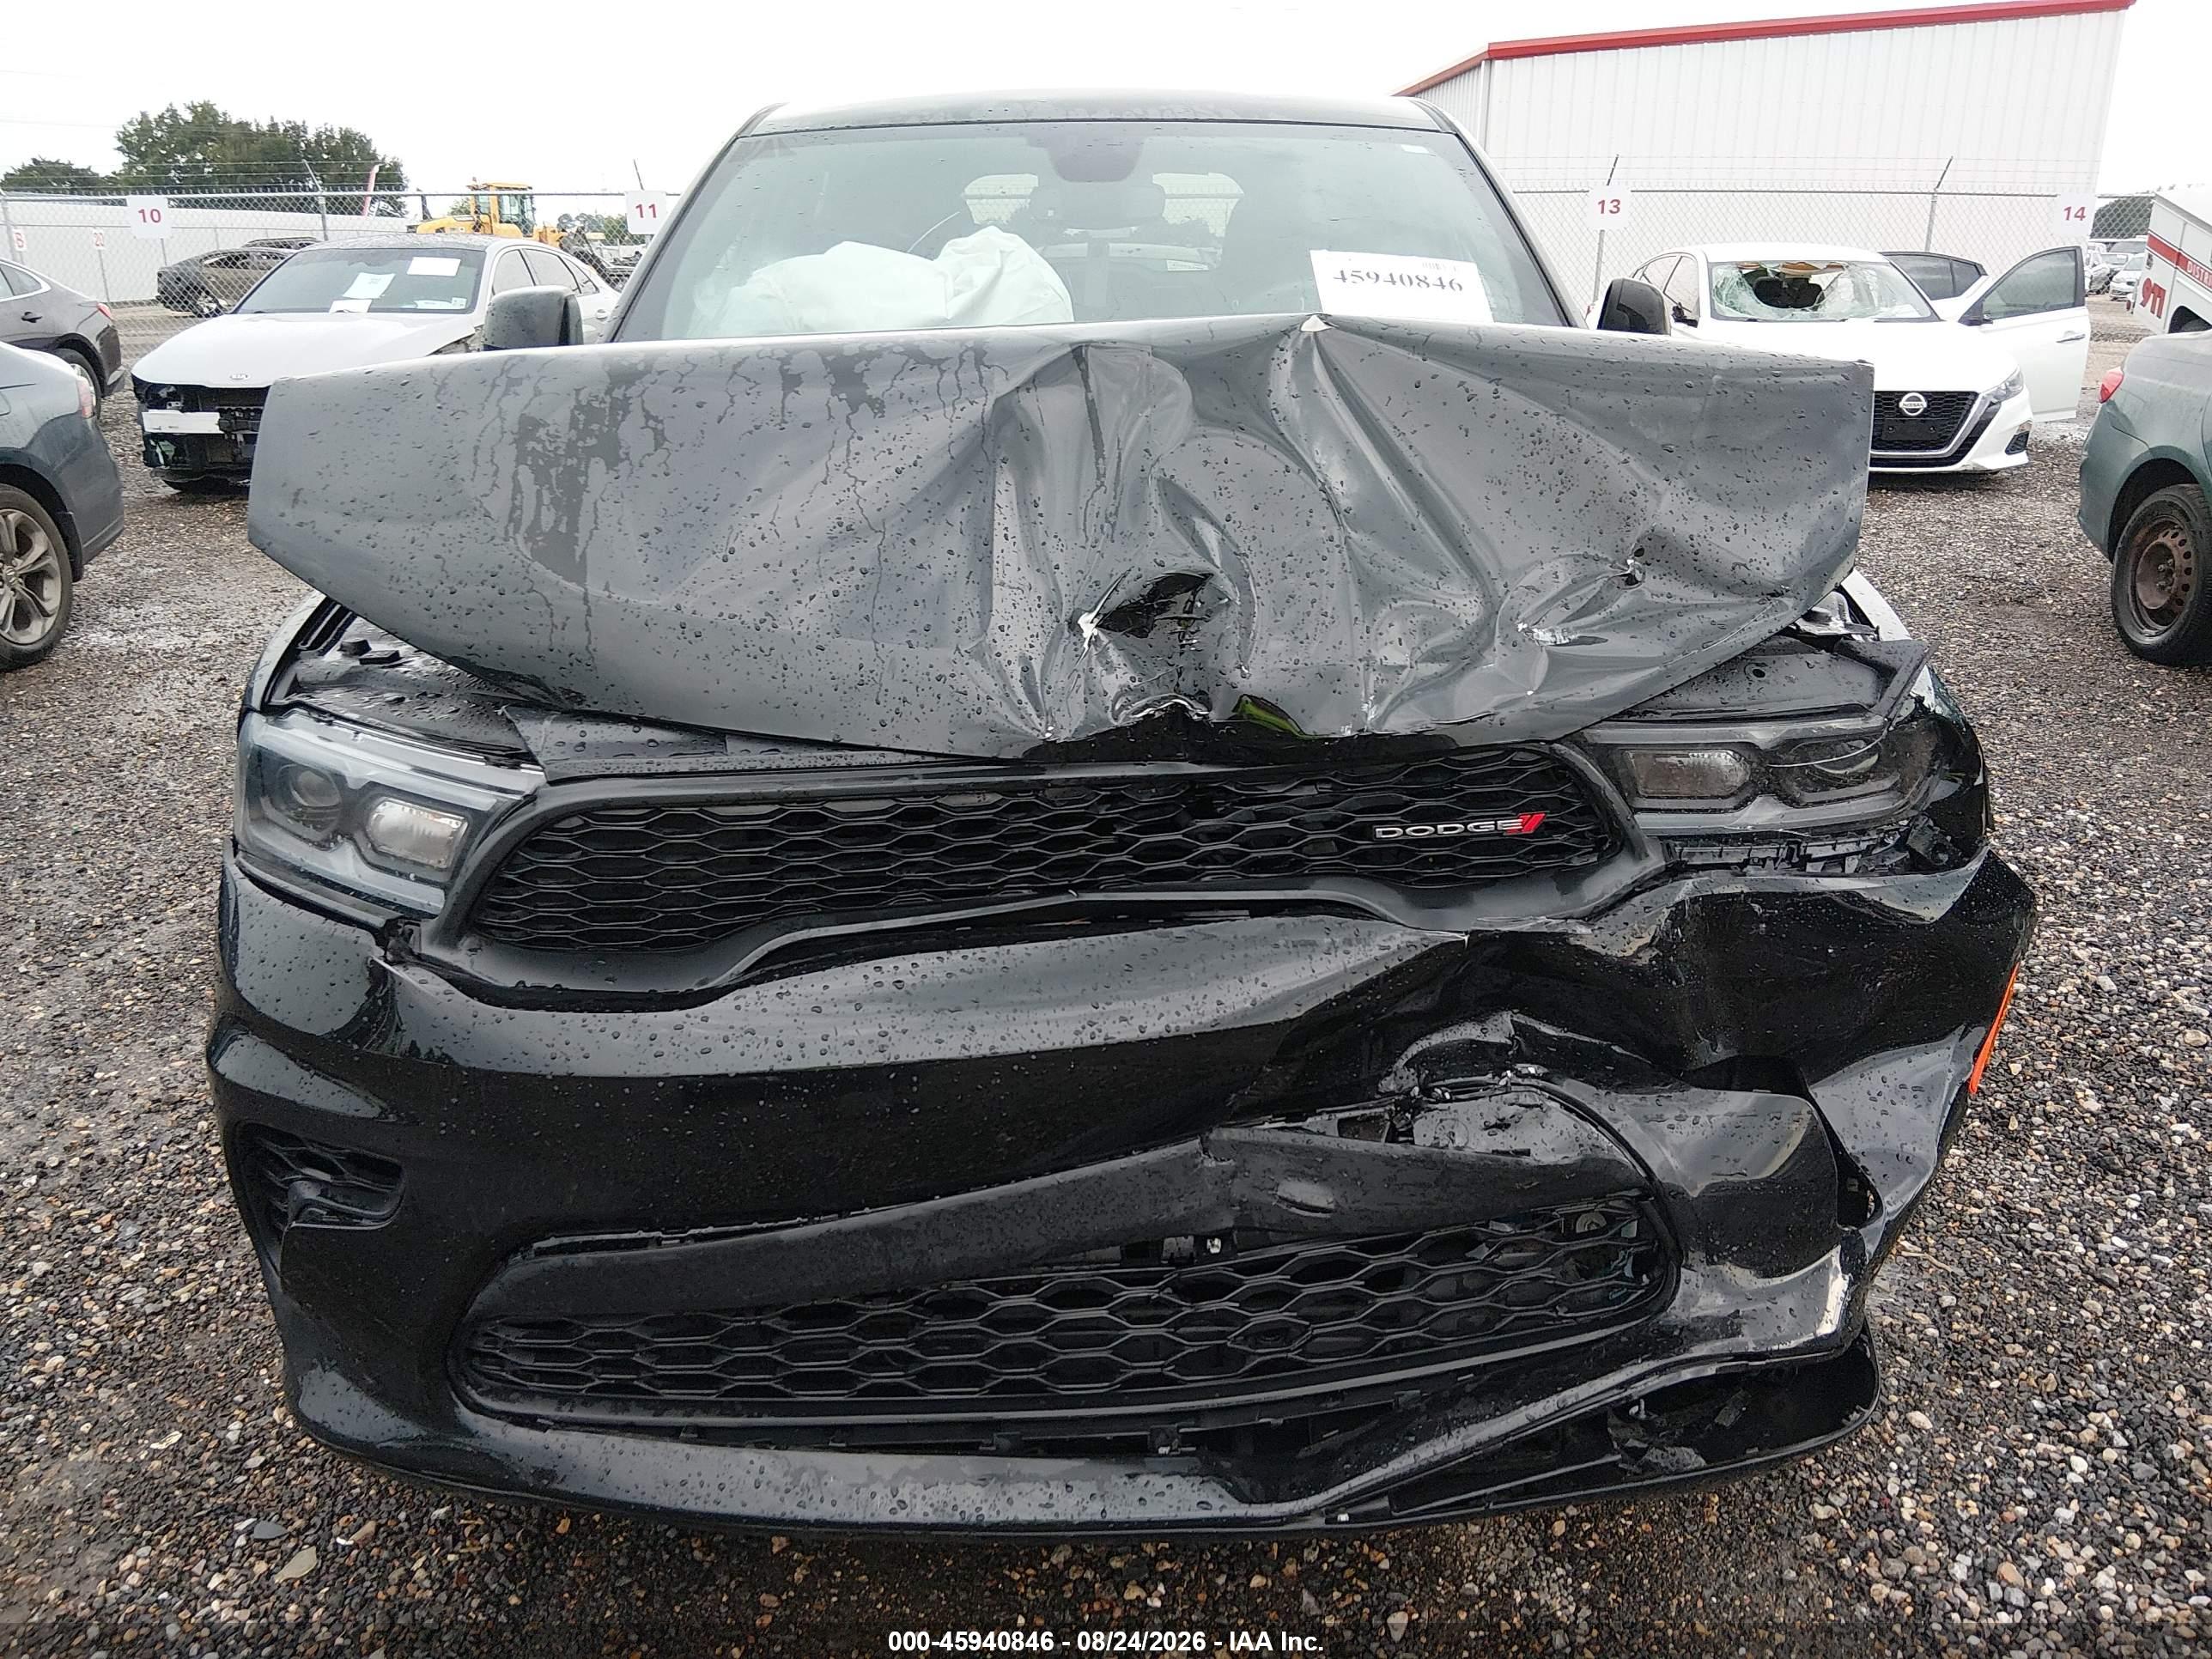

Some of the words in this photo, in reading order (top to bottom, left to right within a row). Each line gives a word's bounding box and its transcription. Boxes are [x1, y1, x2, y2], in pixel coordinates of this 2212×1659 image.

[635, 204, 657, 218] 11
[1597, 199, 1621, 214] 13
[2063, 206, 2087, 221] 14
[138, 209, 161, 223] 10
[1332, 269, 1463, 293] 45940846
[2140, 277, 2166, 319] 911
[1375, 818, 1523, 838] DODGE
